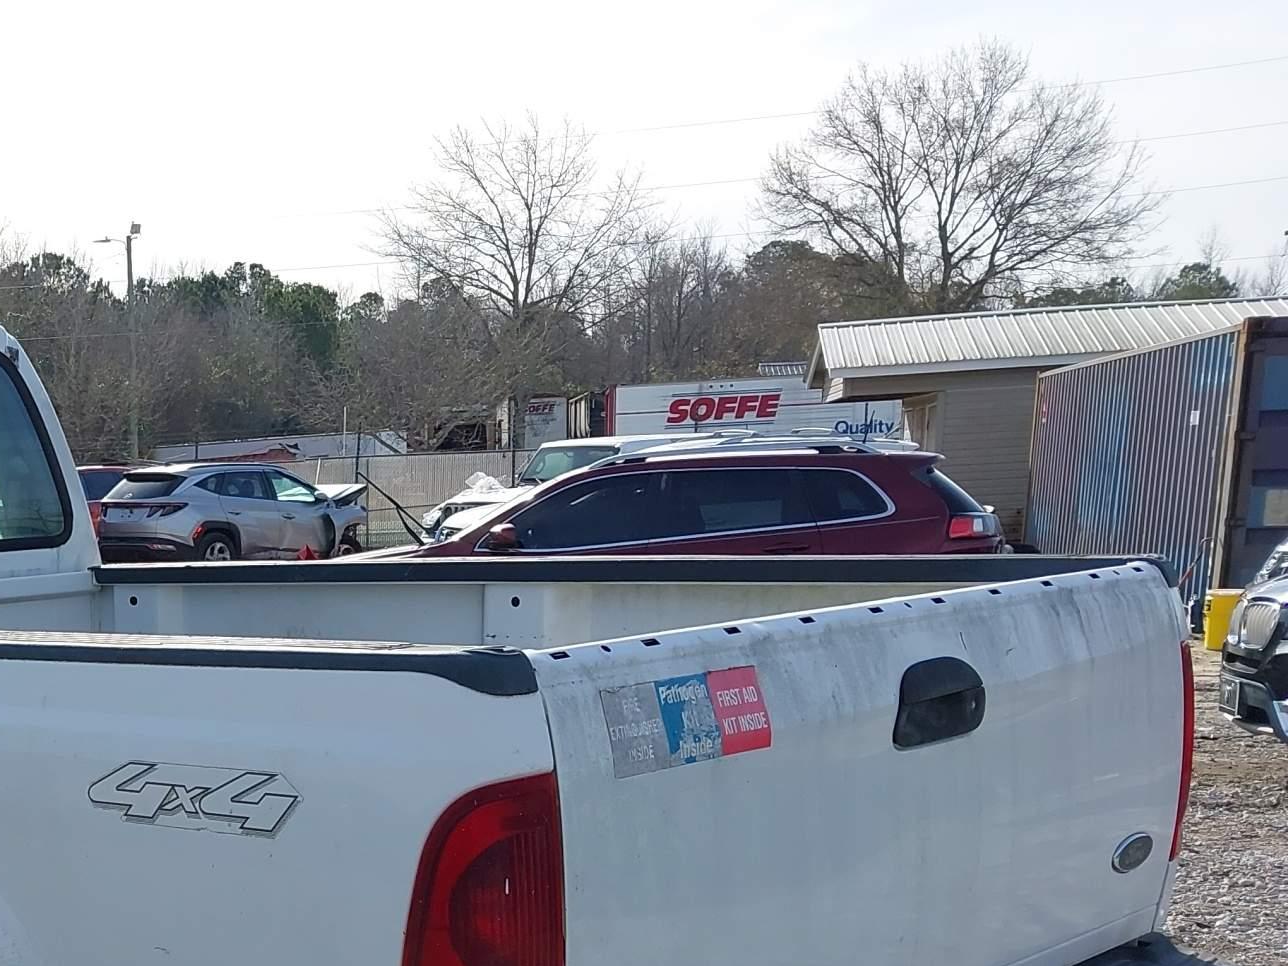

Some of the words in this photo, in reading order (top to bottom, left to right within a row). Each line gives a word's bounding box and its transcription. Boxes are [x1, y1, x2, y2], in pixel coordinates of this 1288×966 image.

[524, 403, 555, 414] OFFE
[666, 393, 781, 424] SOFFE
[834, 419, 895, 436] Quality
[658, 682, 708, 705] Pathogen
[717, 689, 741, 707] FIRST
[742, 686, 758, 704] AID
[722, 716, 738, 735] KIT
[739, 711, 769, 731] INSIDE
[629, 745, 655, 761] INSIDE
[679, 736, 713, 759] Inside
[88, 761, 302, 838] 4x4
